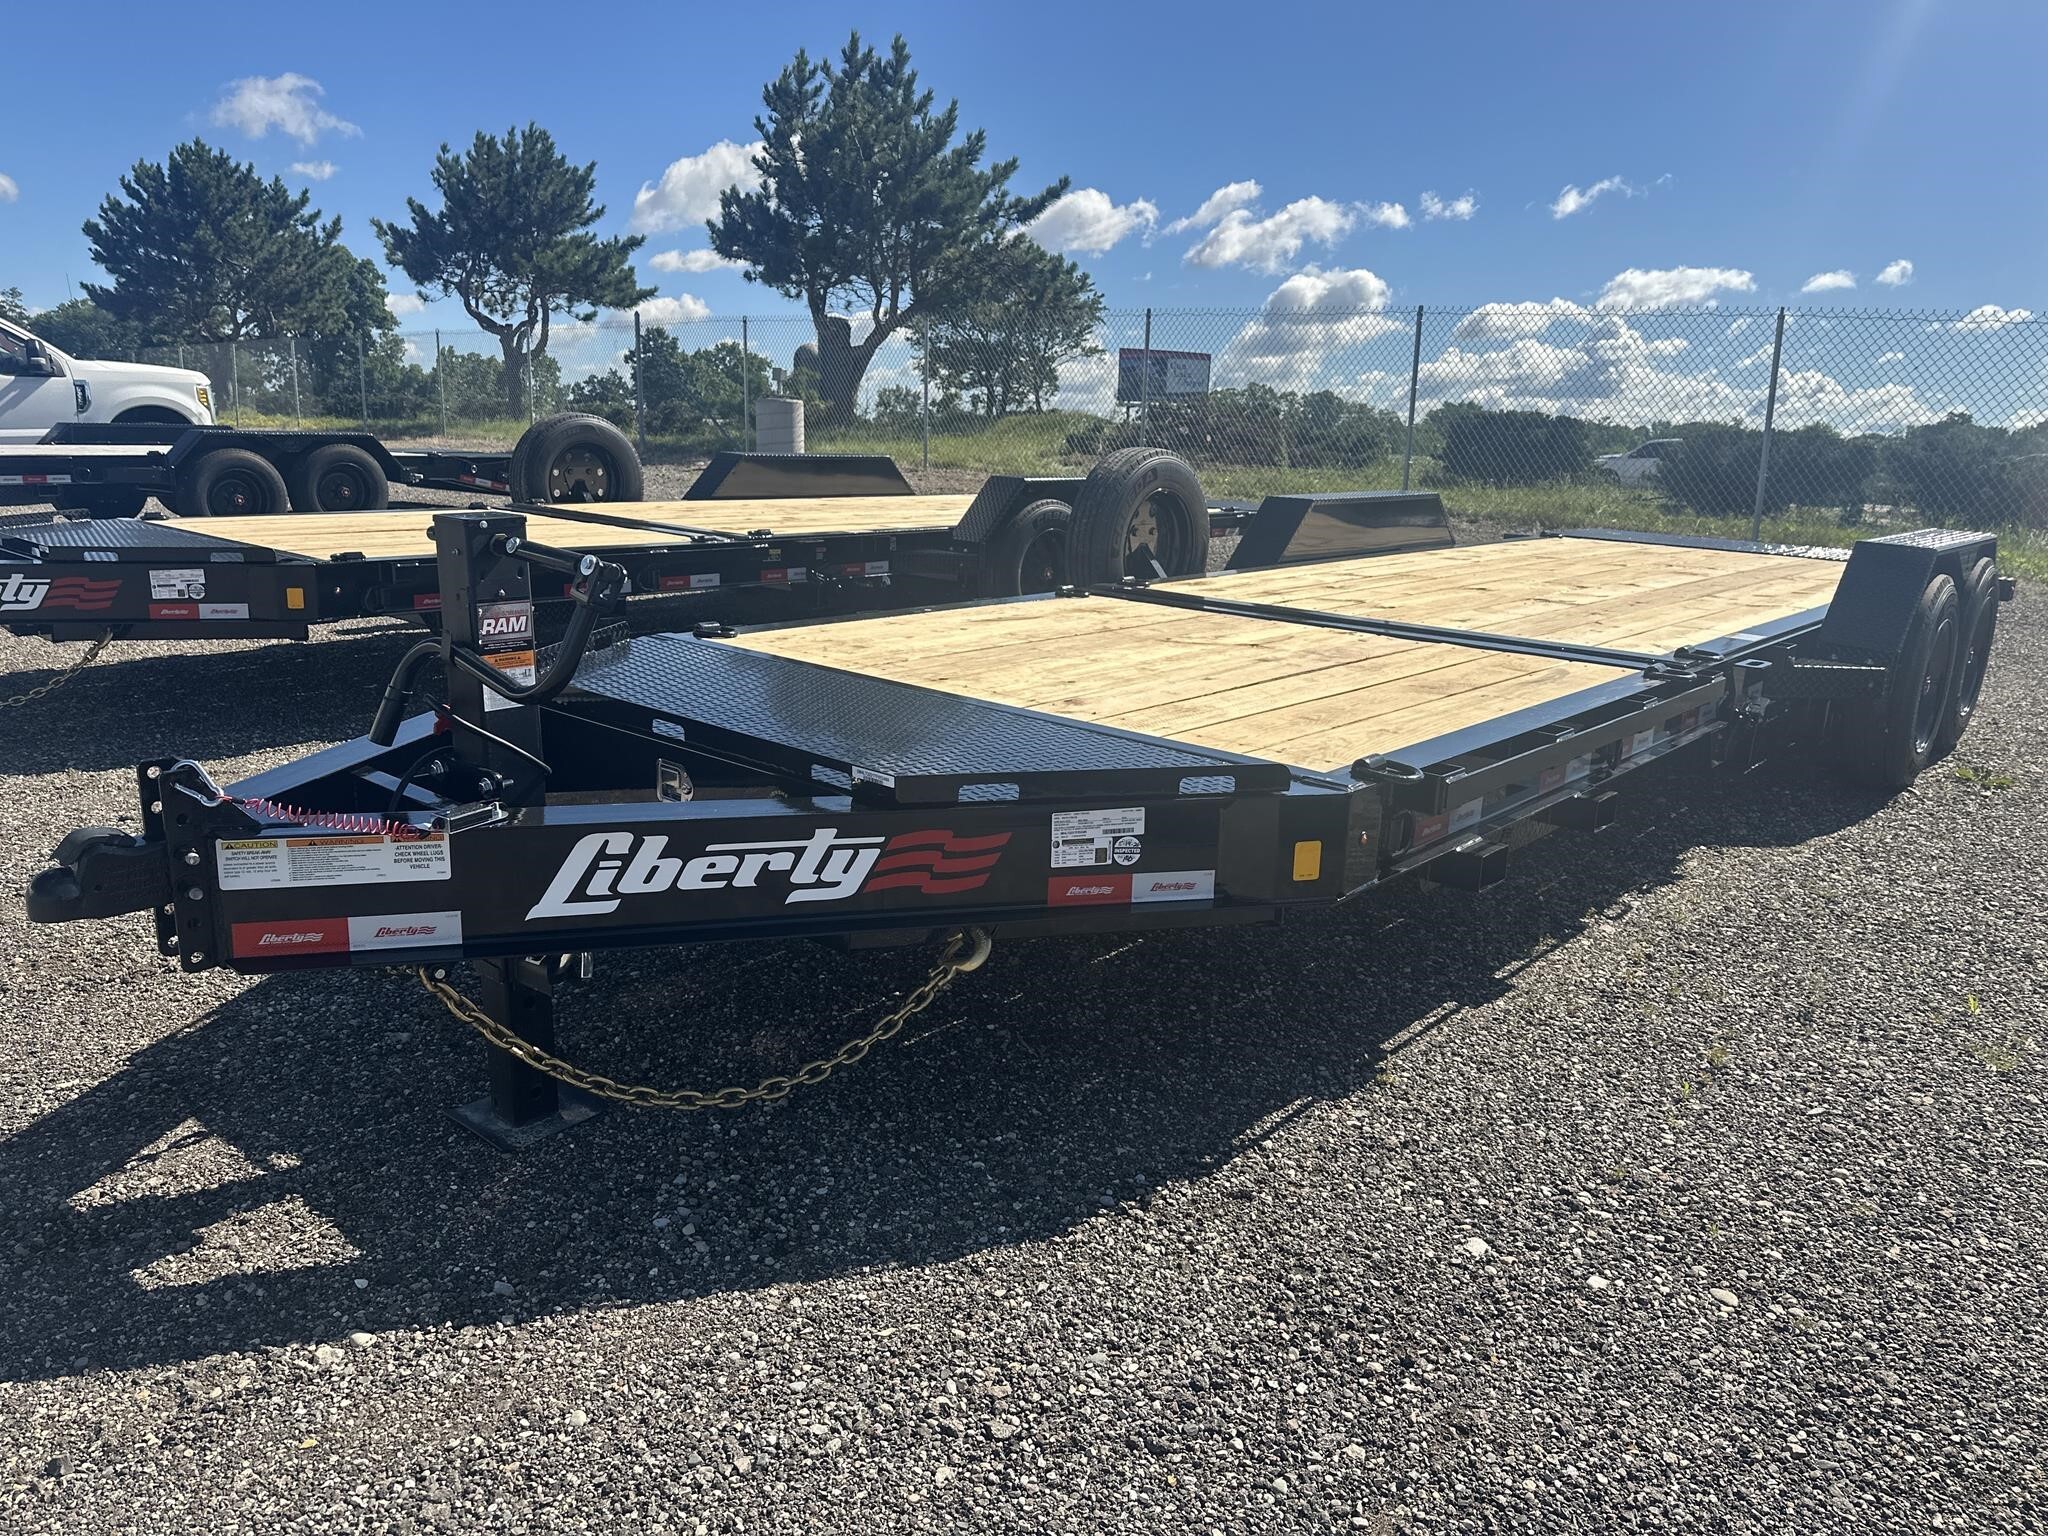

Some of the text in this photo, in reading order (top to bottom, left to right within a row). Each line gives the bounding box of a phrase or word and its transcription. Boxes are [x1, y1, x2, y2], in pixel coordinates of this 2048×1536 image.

[0, 573, 51, 611] ty
[482, 615, 527, 635] RAM
[234, 840, 277, 849] CAUTION
[524, 828, 886, 921] Liberty
[1066, 886, 1102, 896] Liberty
[1150, 882, 1183, 892] Liberty
[374, 926, 418, 938] Liberty
[258, 933, 305, 945] Liberty
